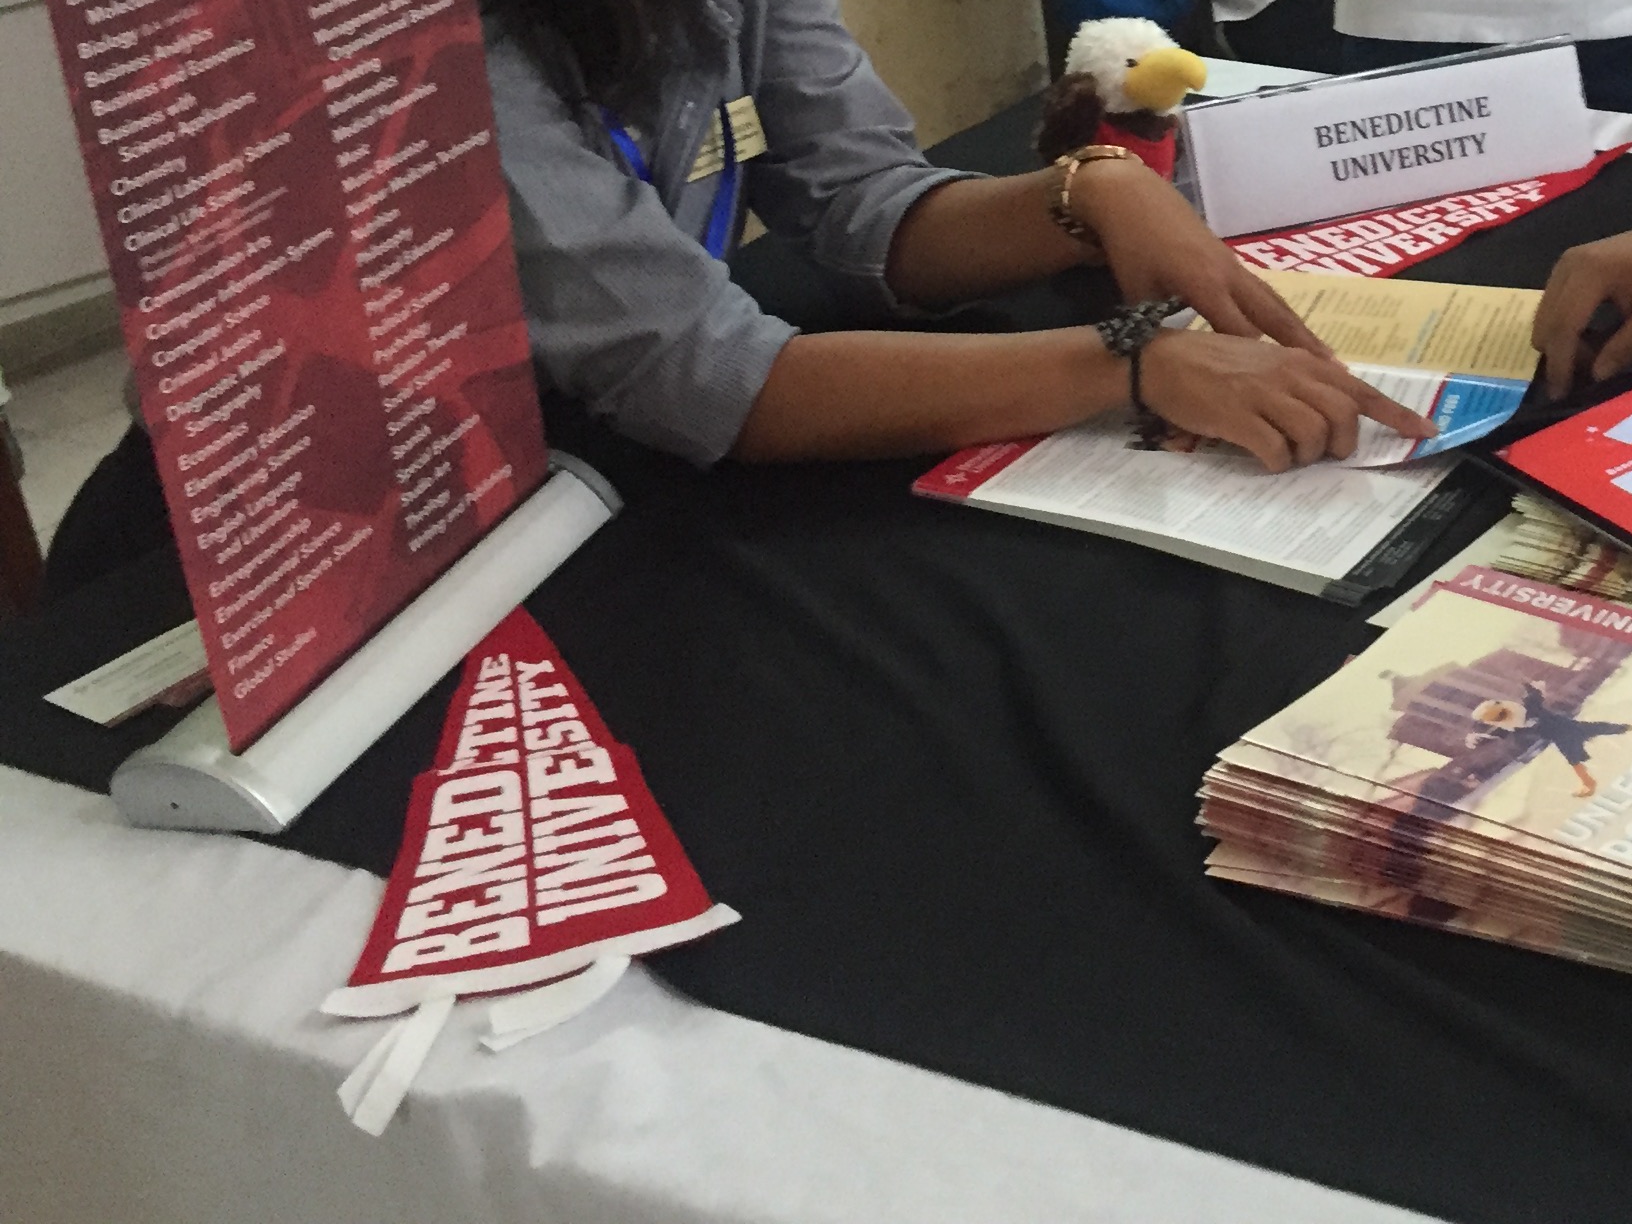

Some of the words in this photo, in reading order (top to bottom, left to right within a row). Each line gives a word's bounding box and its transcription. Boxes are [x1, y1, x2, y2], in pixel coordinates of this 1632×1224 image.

[1313, 94, 1493, 149] BENEDICTINE
[1329, 132, 1489, 183] UNIVERSITY
[1234, 179, 1547, 272] ENEDICTINE
